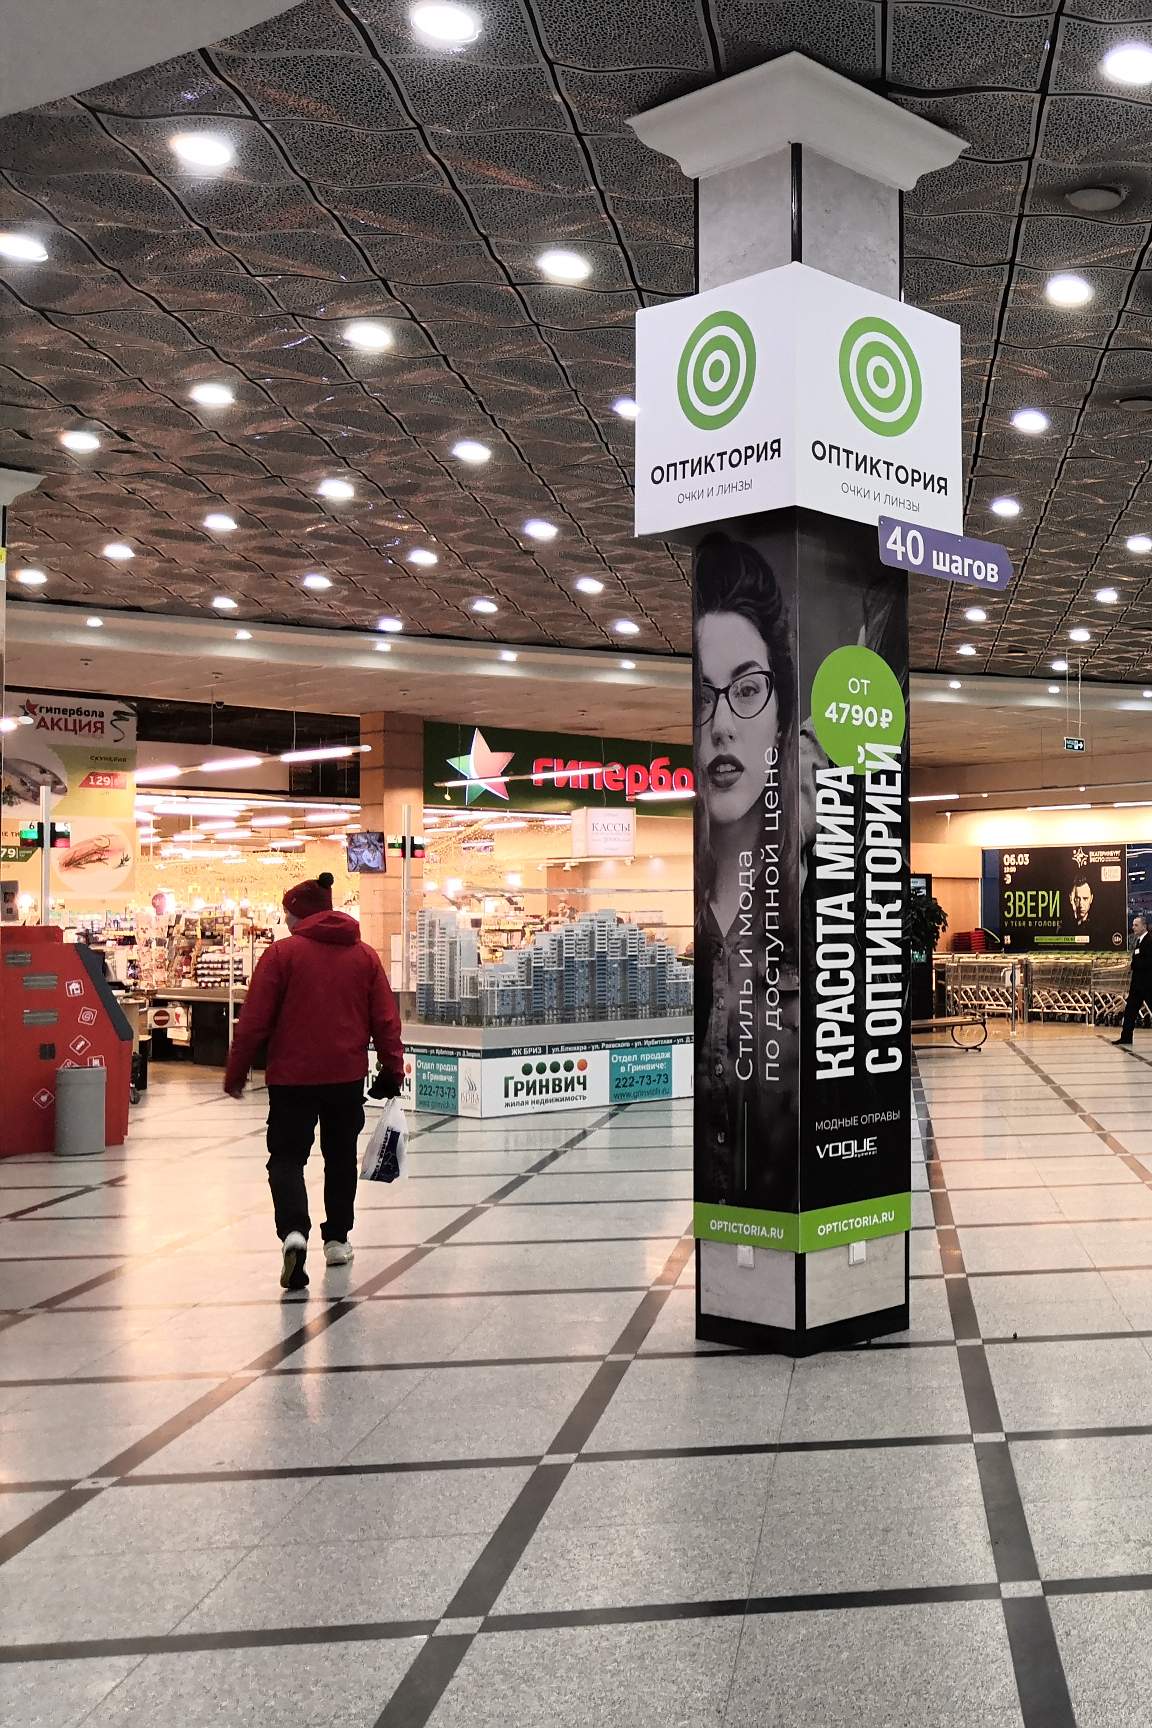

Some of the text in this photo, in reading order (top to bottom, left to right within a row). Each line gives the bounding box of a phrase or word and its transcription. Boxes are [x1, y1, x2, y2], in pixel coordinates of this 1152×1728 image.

[651, 438, 782, 485] ОПТИКТОРИЯ
[811, 440, 948, 496] ОПТИКТОРИЯ
[677, 479, 753, 504] ОЧКИ И ЛИНЗЫ
[841, 482, 920, 513] ОЧКИ И ЛИНЗЫ
[886, 525, 999, 584] 40 шагов
[848, 677, 871, 696] ОТ
[39, 705, 105, 719] гипербола
[824, 702, 893, 729] 4790₽
[36, 716, 105, 735] АКЦИЯ
[89, 775, 111, 786] 129
[532, 757, 695, 802] гипербо
[28, 821, 35, 830] 6
[592, 822, 631, 833] КАССЫ
[1003, 853, 1030, 866] 06.03
[760, 746, 784, 1081] по доступной цене
[857, 742, 903, 1075] С ОПТИКТОРИЕЙ
[1004, 890, 1060, 918] ЗВЕРИ
[816, 764, 855, 1081] КРАСОТА МИРА
[735, 850, 756, 1081] Стиль и мода
[511, 1048, 522, 1056] ЖК
[523, 1047, 542, 1056] БРИЗ
[611, 1051, 671, 1064] Отдел продаж
[627, 1061, 667, 1074] Гринвиче:
[419, 1084, 456, 1099] 222-73-73
[614, 1073, 669, 1089] 222-73-73
[504, 1094, 587, 1109] жилая недвижимость
[815, 1109, 901, 1132] МОДНЫЕ ОПРАВЫ
[709, 1219, 784, 1240] OPTICTORIA.RU
[817, 1210, 895, 1237] OPTICTORIA.RU
